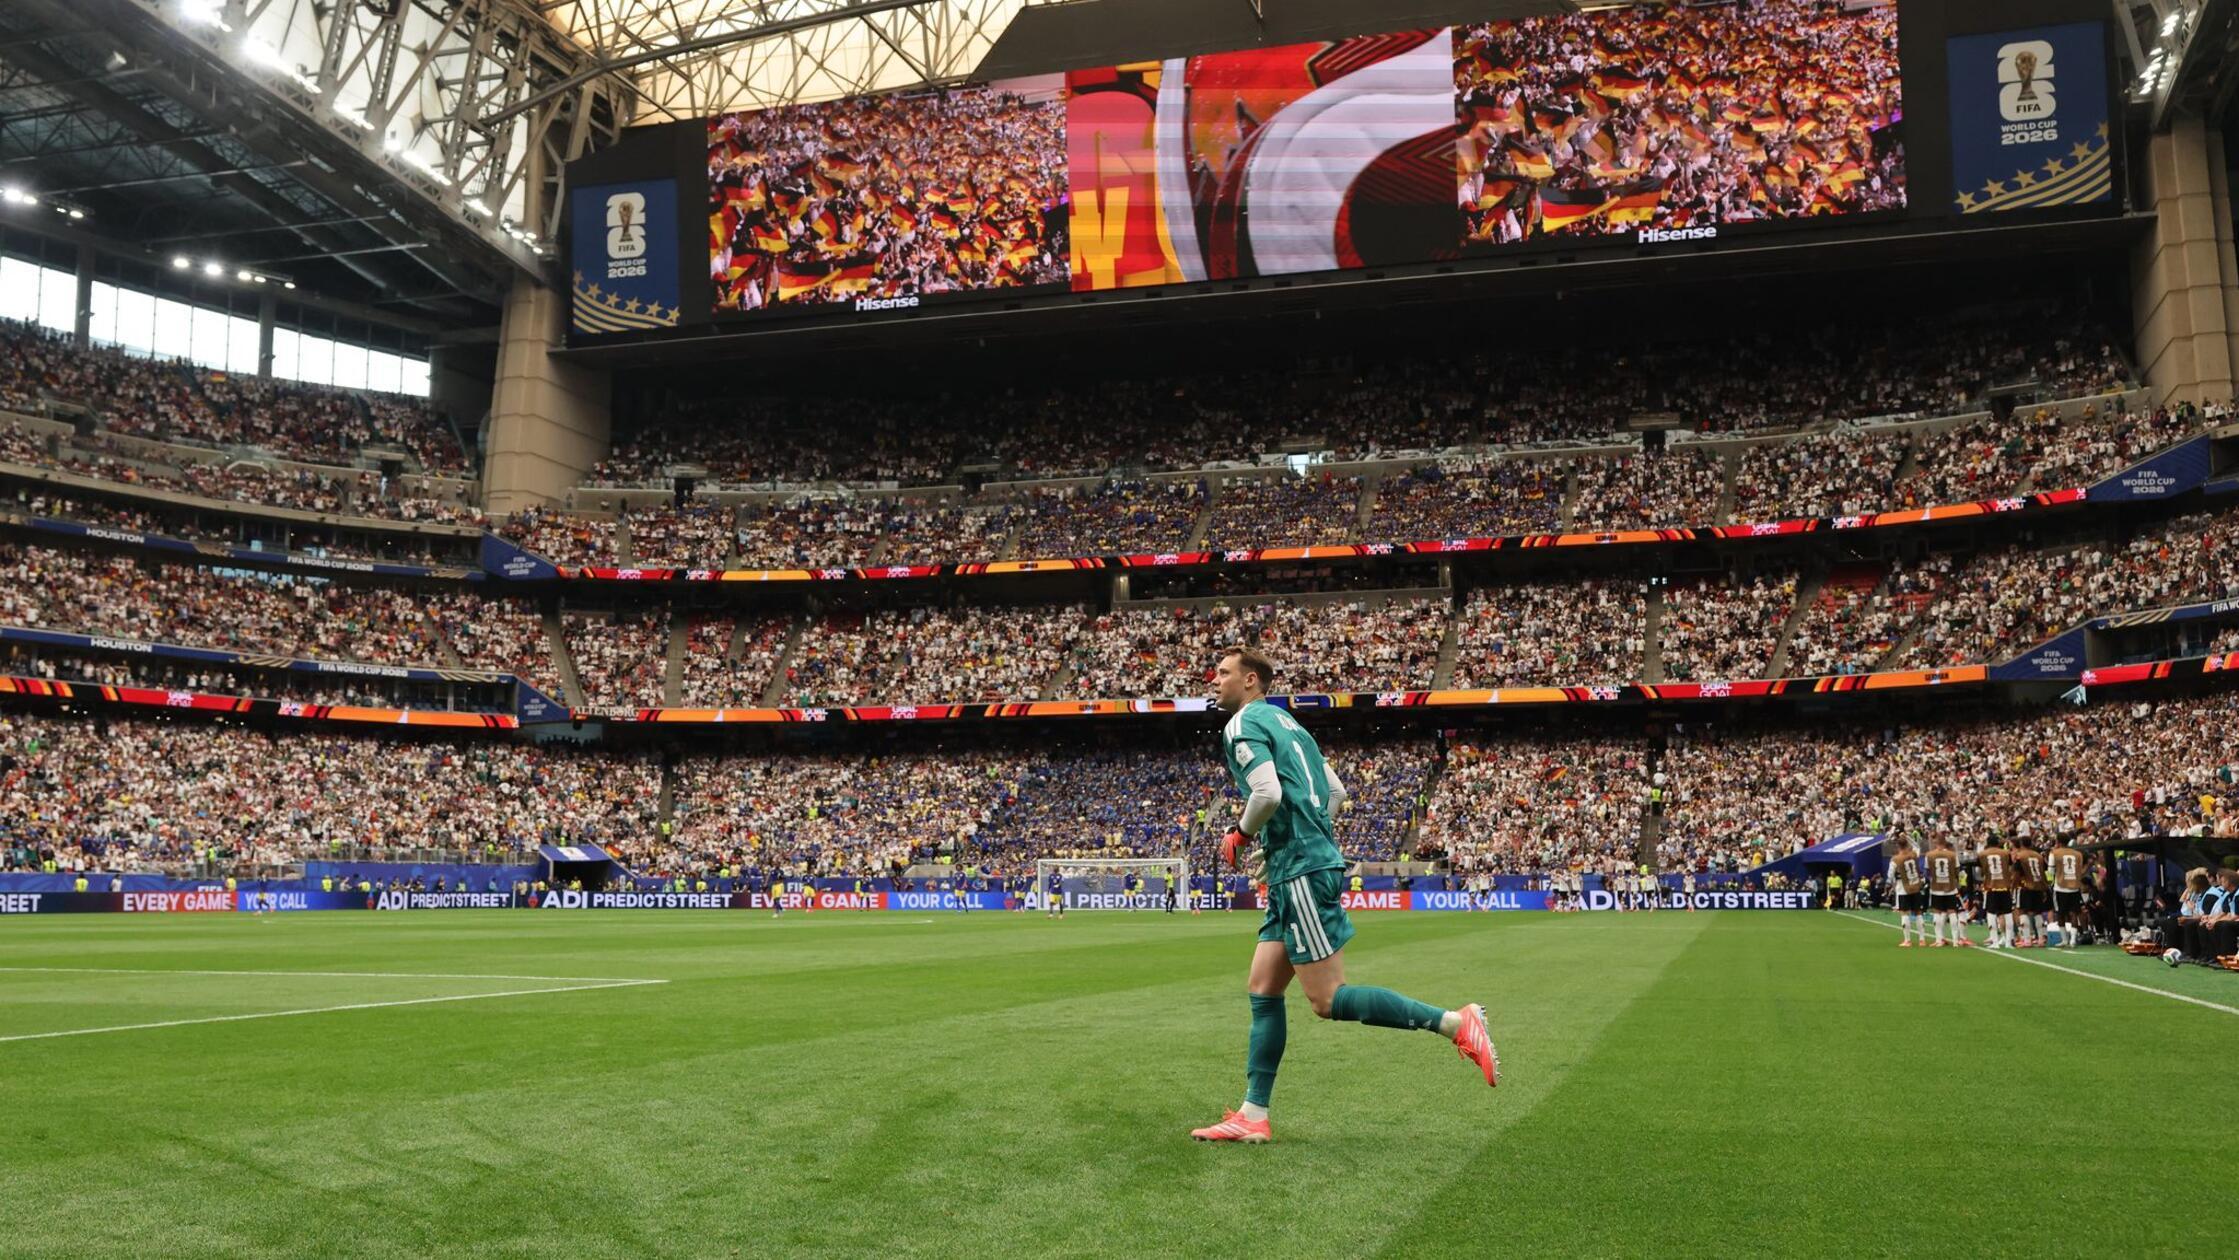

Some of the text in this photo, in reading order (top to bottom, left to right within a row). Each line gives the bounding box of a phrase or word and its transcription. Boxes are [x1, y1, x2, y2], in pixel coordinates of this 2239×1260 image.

[2016, 104, 2041, 113] FIFA
[2001, 120, 2057, 132] WORLD CUP
[2001, 129, 2058, 145] 2026
[1638, 227, 1717, 243] Hisense
[608, 259, 632, 268] WORLD
[608, 266, 647, 278] 2026
[855, 296, 919, 312] Hisense
[2122, 477, 2176, 486] WORLD CUP
[2133, 486, 2165, 494] 2026
[87, 528, 145, 544] HOUSTON
[304, 558, 330, 567] WORLD
[331, 560, 346, 568] CUP
[2212, 602, 2229, 613] FIFA
[91, 639, 152, 653] HOUSTON
[2031, 656, 2075, 665] WORLD CUP
[318, 663, 336, 672] FIFA
[336, 664, 364, 673] WORLD
[365, 666, 381, 674] CUP
[1292, 740, 1321, 808] 1
[123, 893, 232, 912] EVERY GAME
[279, 892, 308, 909] CALL
[376, 891, 510, 910] ADI PREDICTSTREET
[542, 890, 733, 909] ADI PREDICTSTREET
[821, 893, 879, 908] GAME
[898, 893, 944, 908] YOUR
[1340, 893, 1401, 908] GAME
[1423, 892, 1470, 908] YOUR
[1290, 922, 1306, 954] 1
